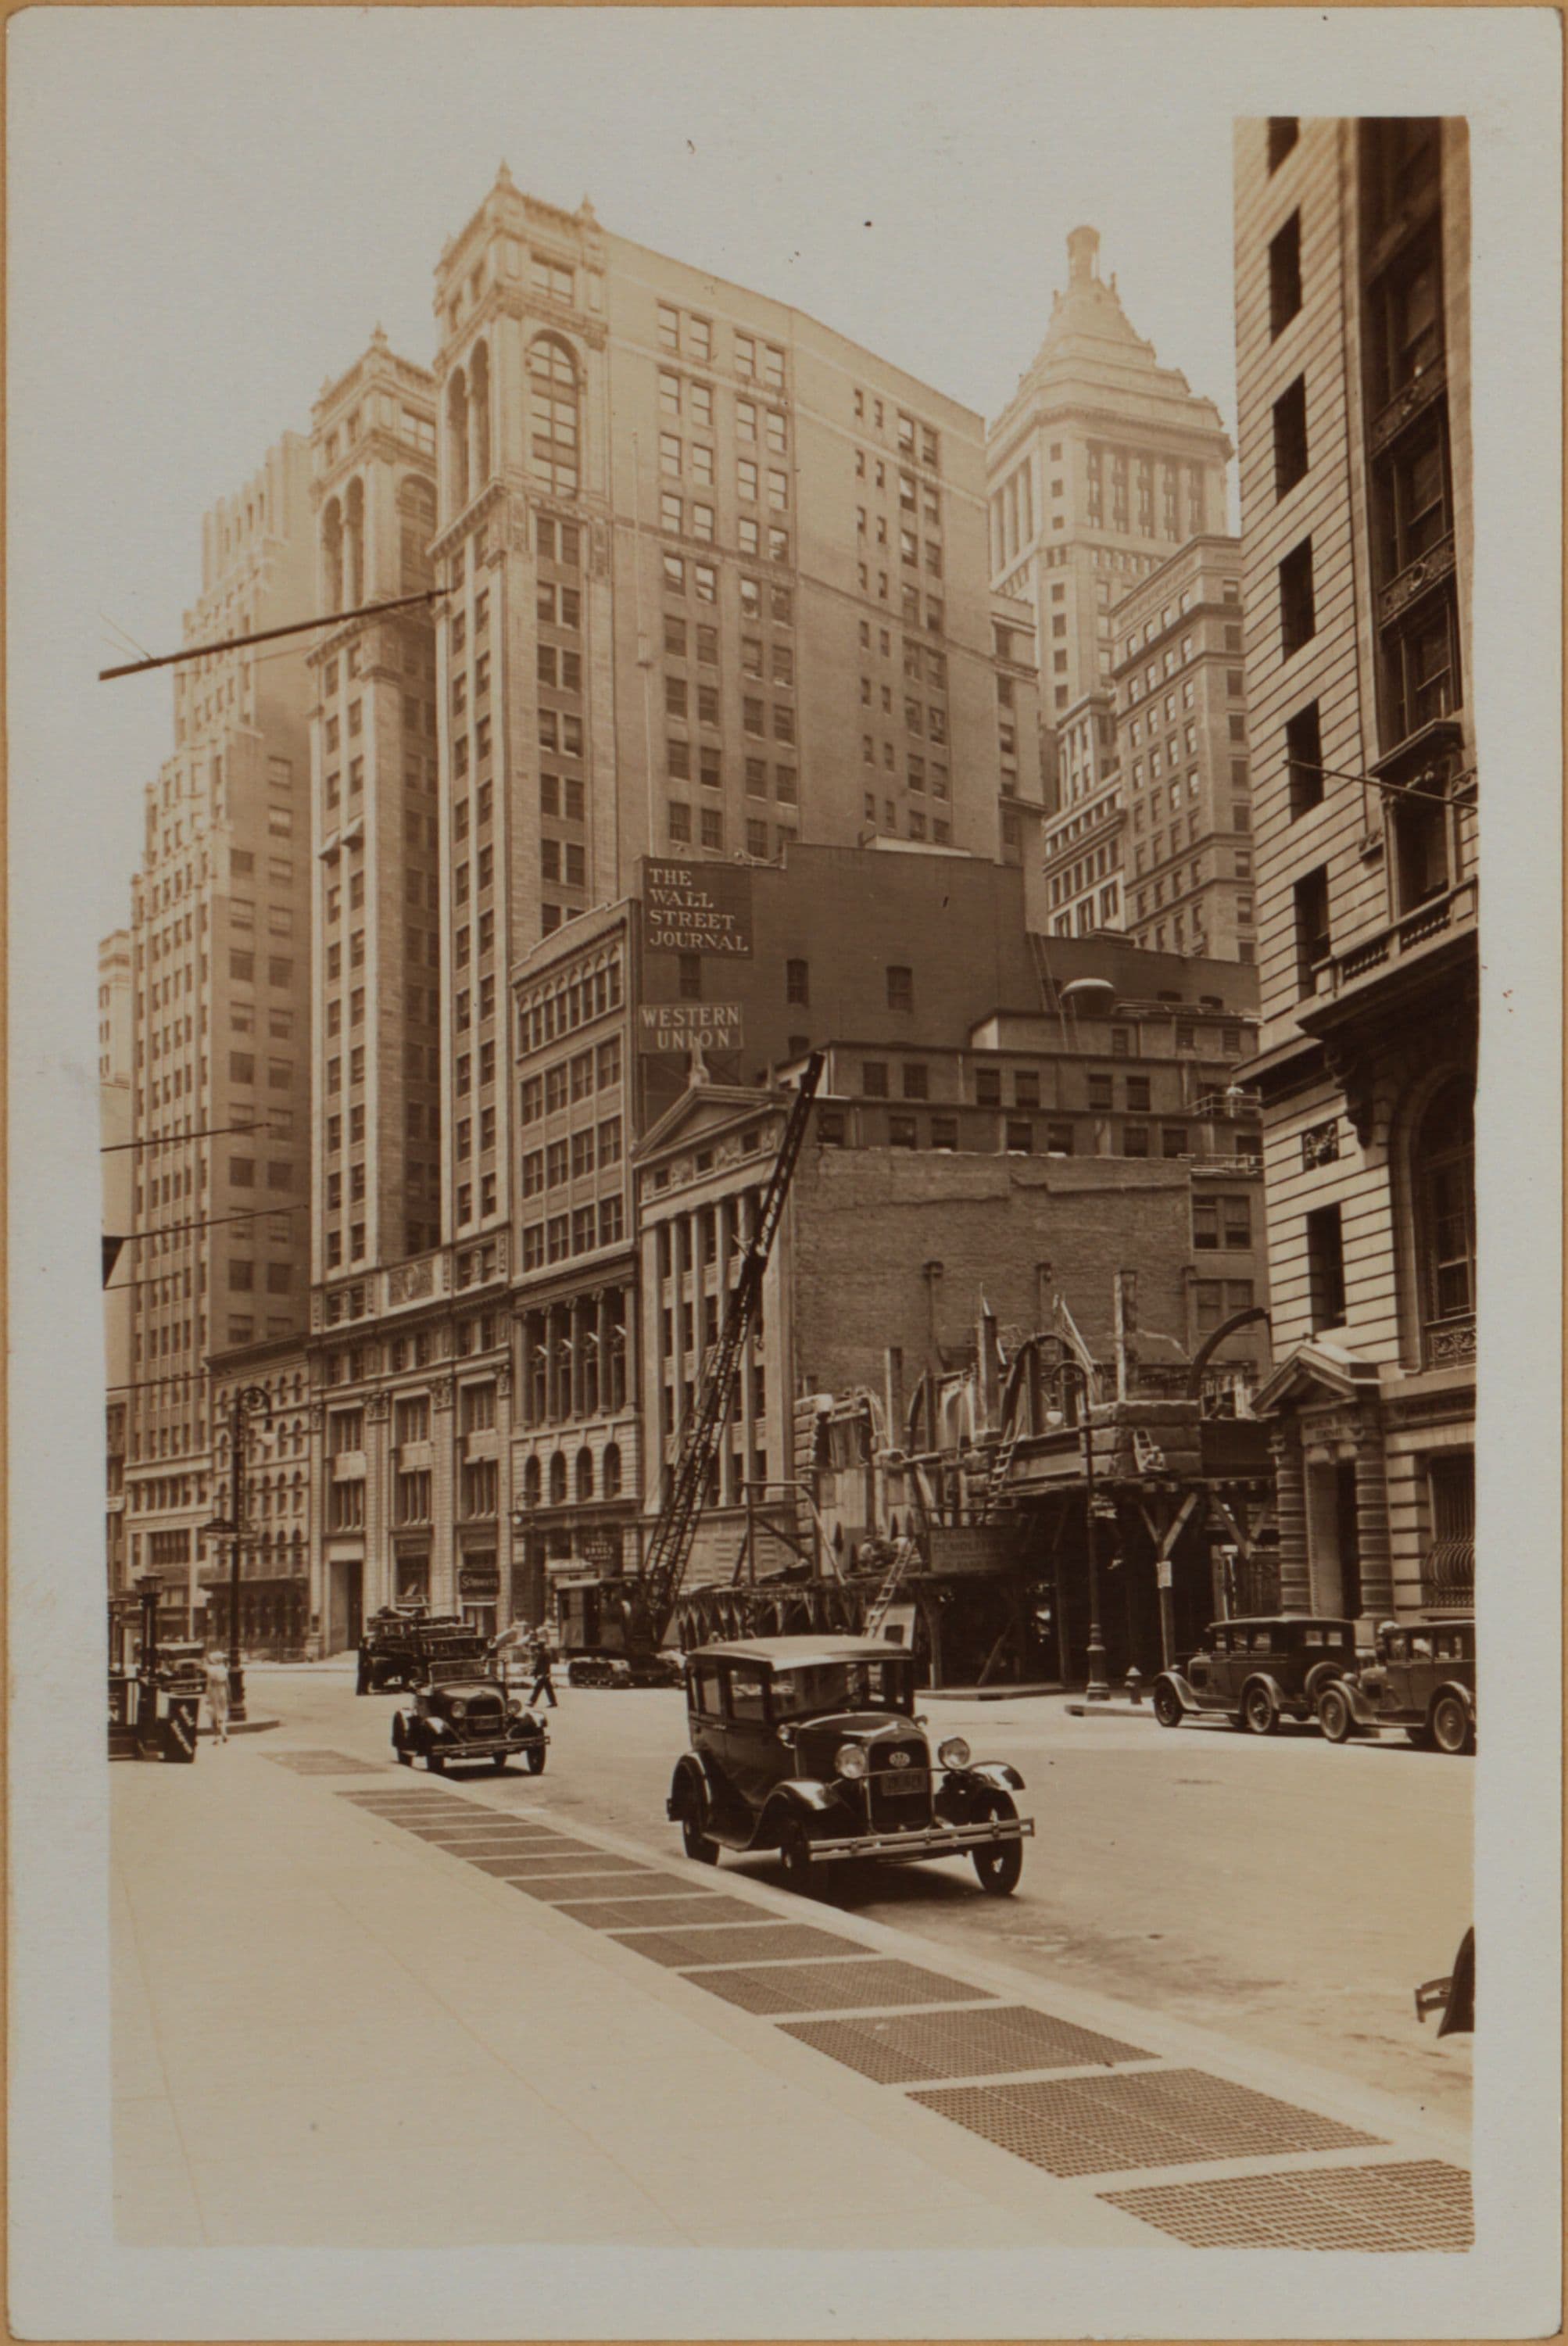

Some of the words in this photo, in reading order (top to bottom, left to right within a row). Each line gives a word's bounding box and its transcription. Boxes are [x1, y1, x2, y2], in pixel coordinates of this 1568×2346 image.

[650, 869, 692, 886] THE
[650, 889, 714, 908] WALL
[650, 909, 735, 930] STREET
[650, 931, 748, 951] JOURNAL
[642, 1007, 739, 1027] WESTERN
[657, 1030, 730, 1050] UNION
